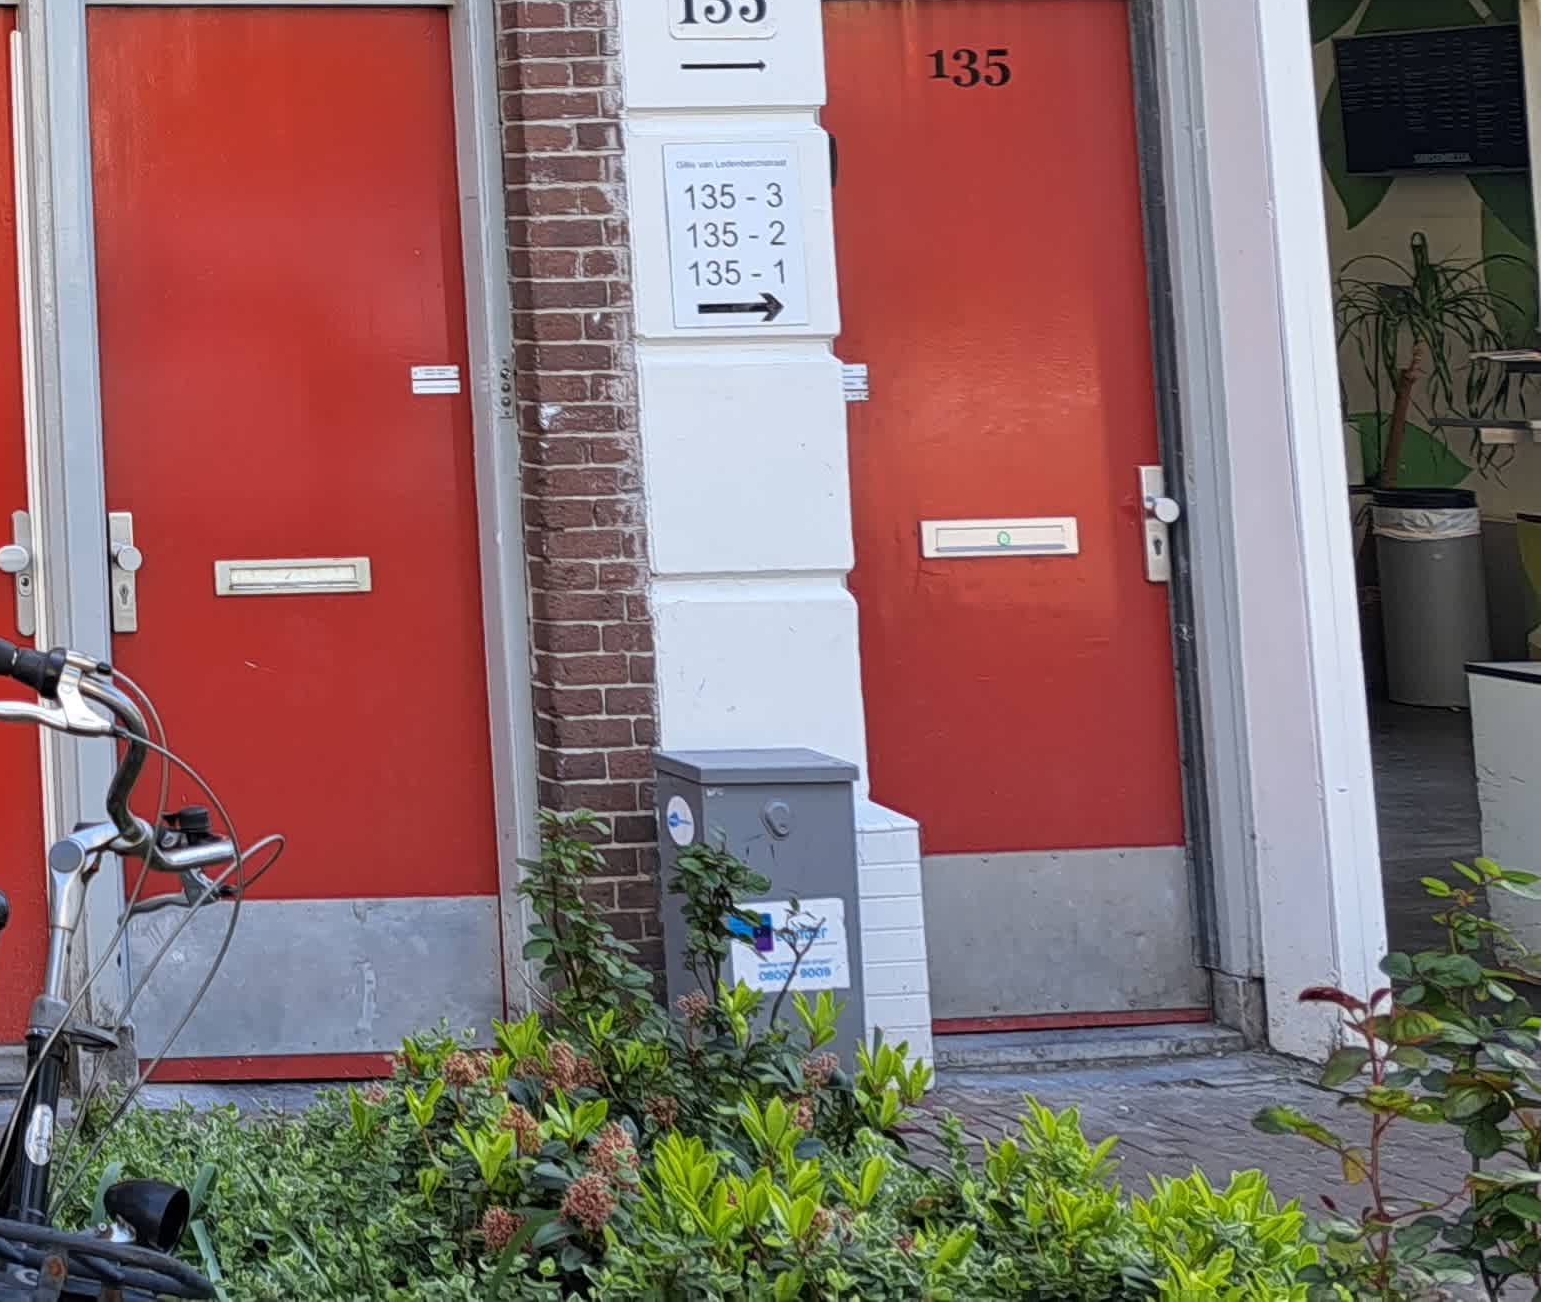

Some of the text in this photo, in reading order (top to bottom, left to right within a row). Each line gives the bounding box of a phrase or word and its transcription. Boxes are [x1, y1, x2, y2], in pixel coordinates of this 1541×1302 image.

[926, 48, 1012, 88] 135
[684, 183, 736, 210] 135
[766, 182, 783, 208] 3
[686, 221, 739, 248] 135
[768, 220, 787, 246] 2
[688, 260, 742, 286] 135
[773, 258, 785, 284] 1
